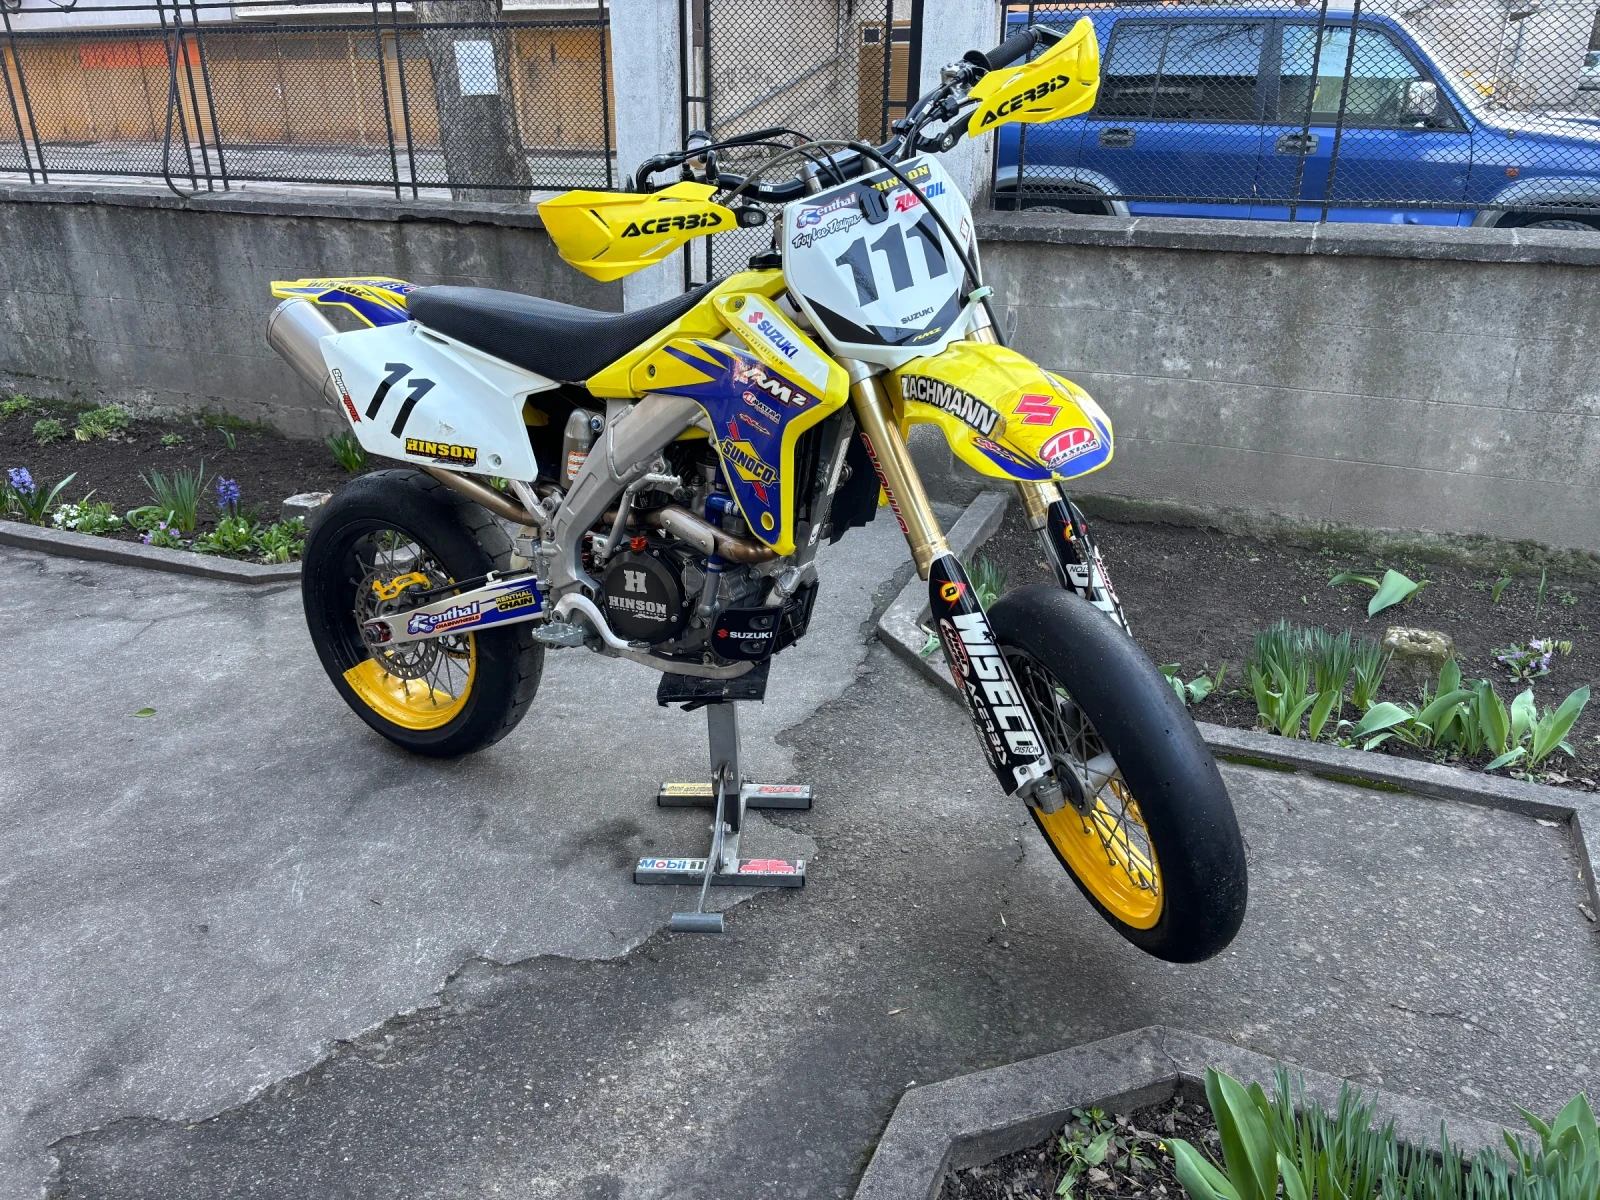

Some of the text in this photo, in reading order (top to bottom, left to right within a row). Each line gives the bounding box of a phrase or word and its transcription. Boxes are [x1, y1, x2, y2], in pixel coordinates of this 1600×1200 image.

[791, 214, 862, 249] Troy Lee Designs
[835, 212, 949, 308] 111
[900, 306, 935, 325] SUZUKI
[757, 320, 799, 360] SUZUKI
[753, 399, 781, 421] MAXIMA
[406, 439, 477, 460] HINSON
[722, 440, 774, 483] SUNOCO
[623, 569, 648, 594] H
[495, 590, 532, 604] RENTHAL
[498, 597, 533, 611] CHAIN
[608, 595, 667, 615] HINSON
[408, 600, 480, 634] Renthal
[435, 615, 480, 629] CHAINWHEELS
[729, 630, 773, 640] SUZUKI
[952, 612, 1044, 756] WISECO
[1013, 745, 1040, 754] PISTON
[640, 859, 687, 869] Mobil
